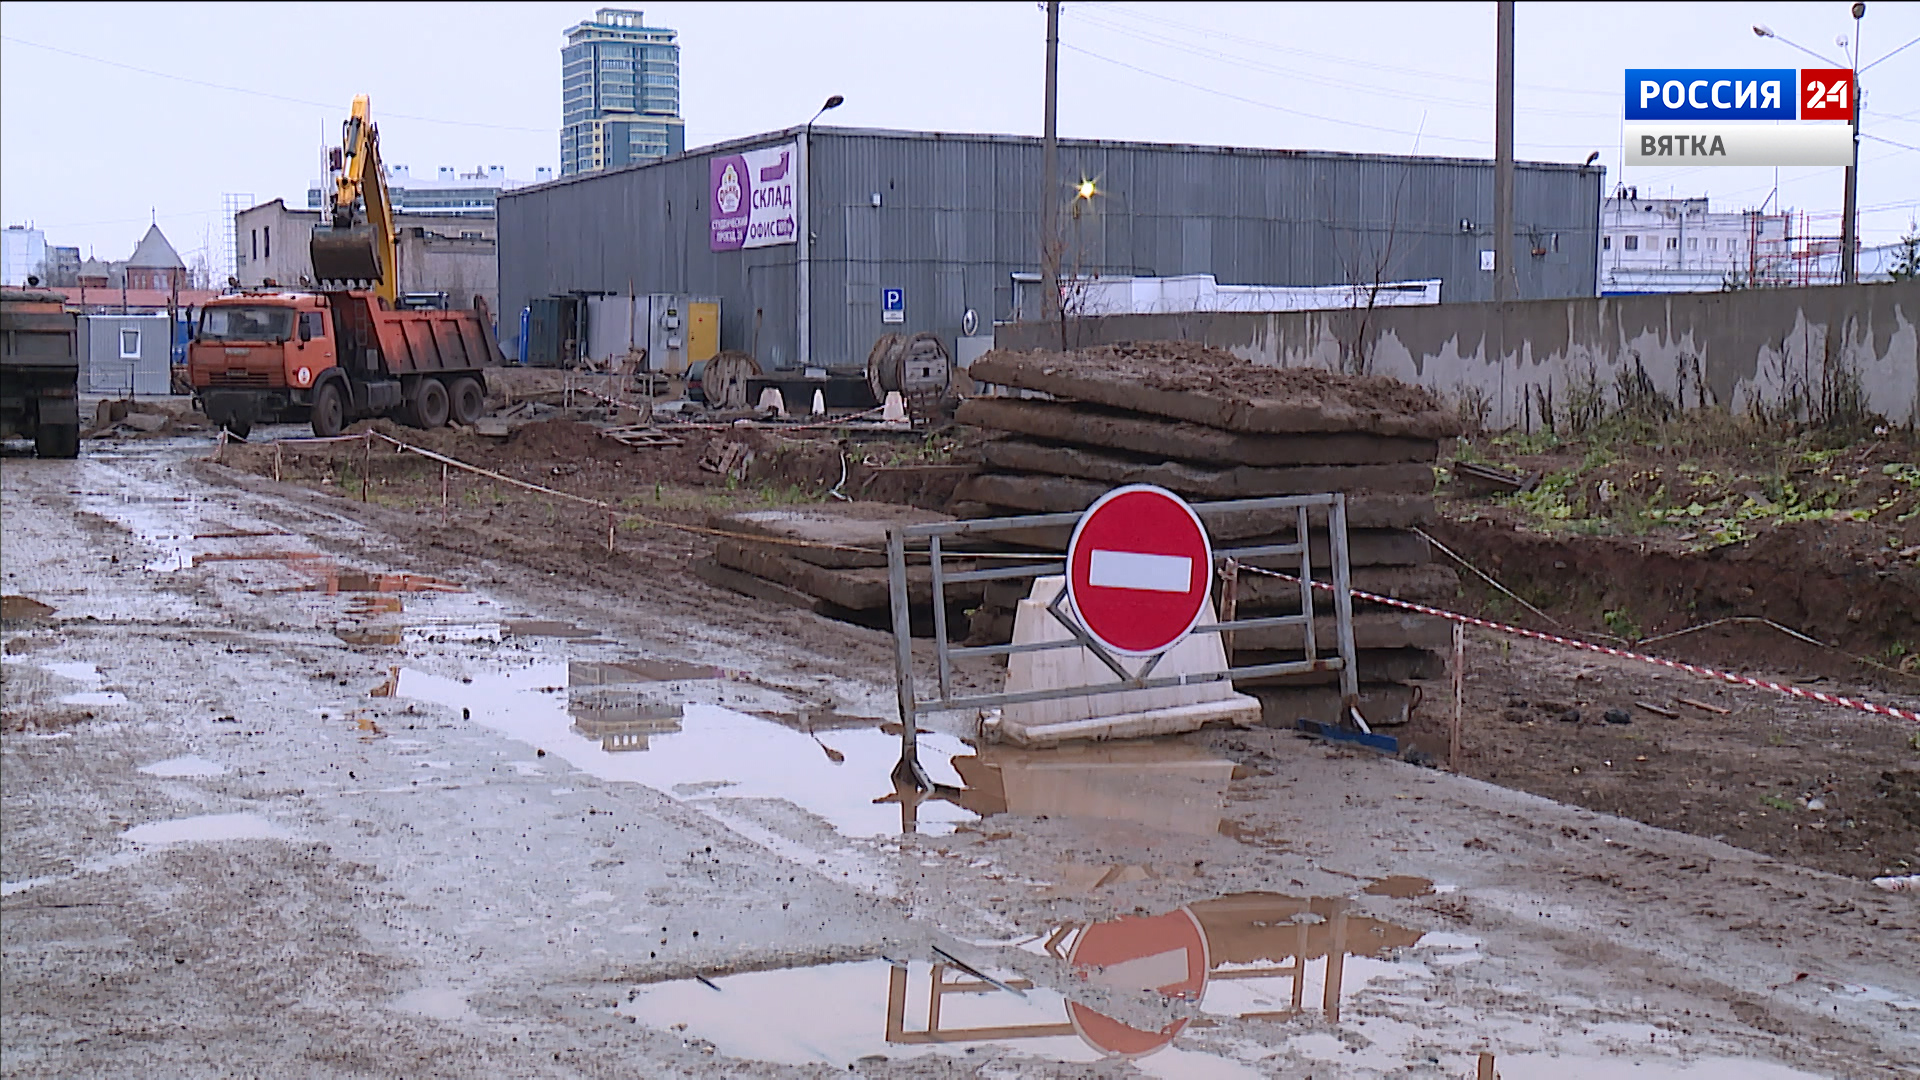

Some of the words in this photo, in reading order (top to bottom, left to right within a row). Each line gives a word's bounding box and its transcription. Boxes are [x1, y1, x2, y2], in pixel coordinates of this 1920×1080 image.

[753, 186, 792, 209] СКЛАД
[751, 221, 776, 239] ОФИС
[888, 291, 899, 309] P
